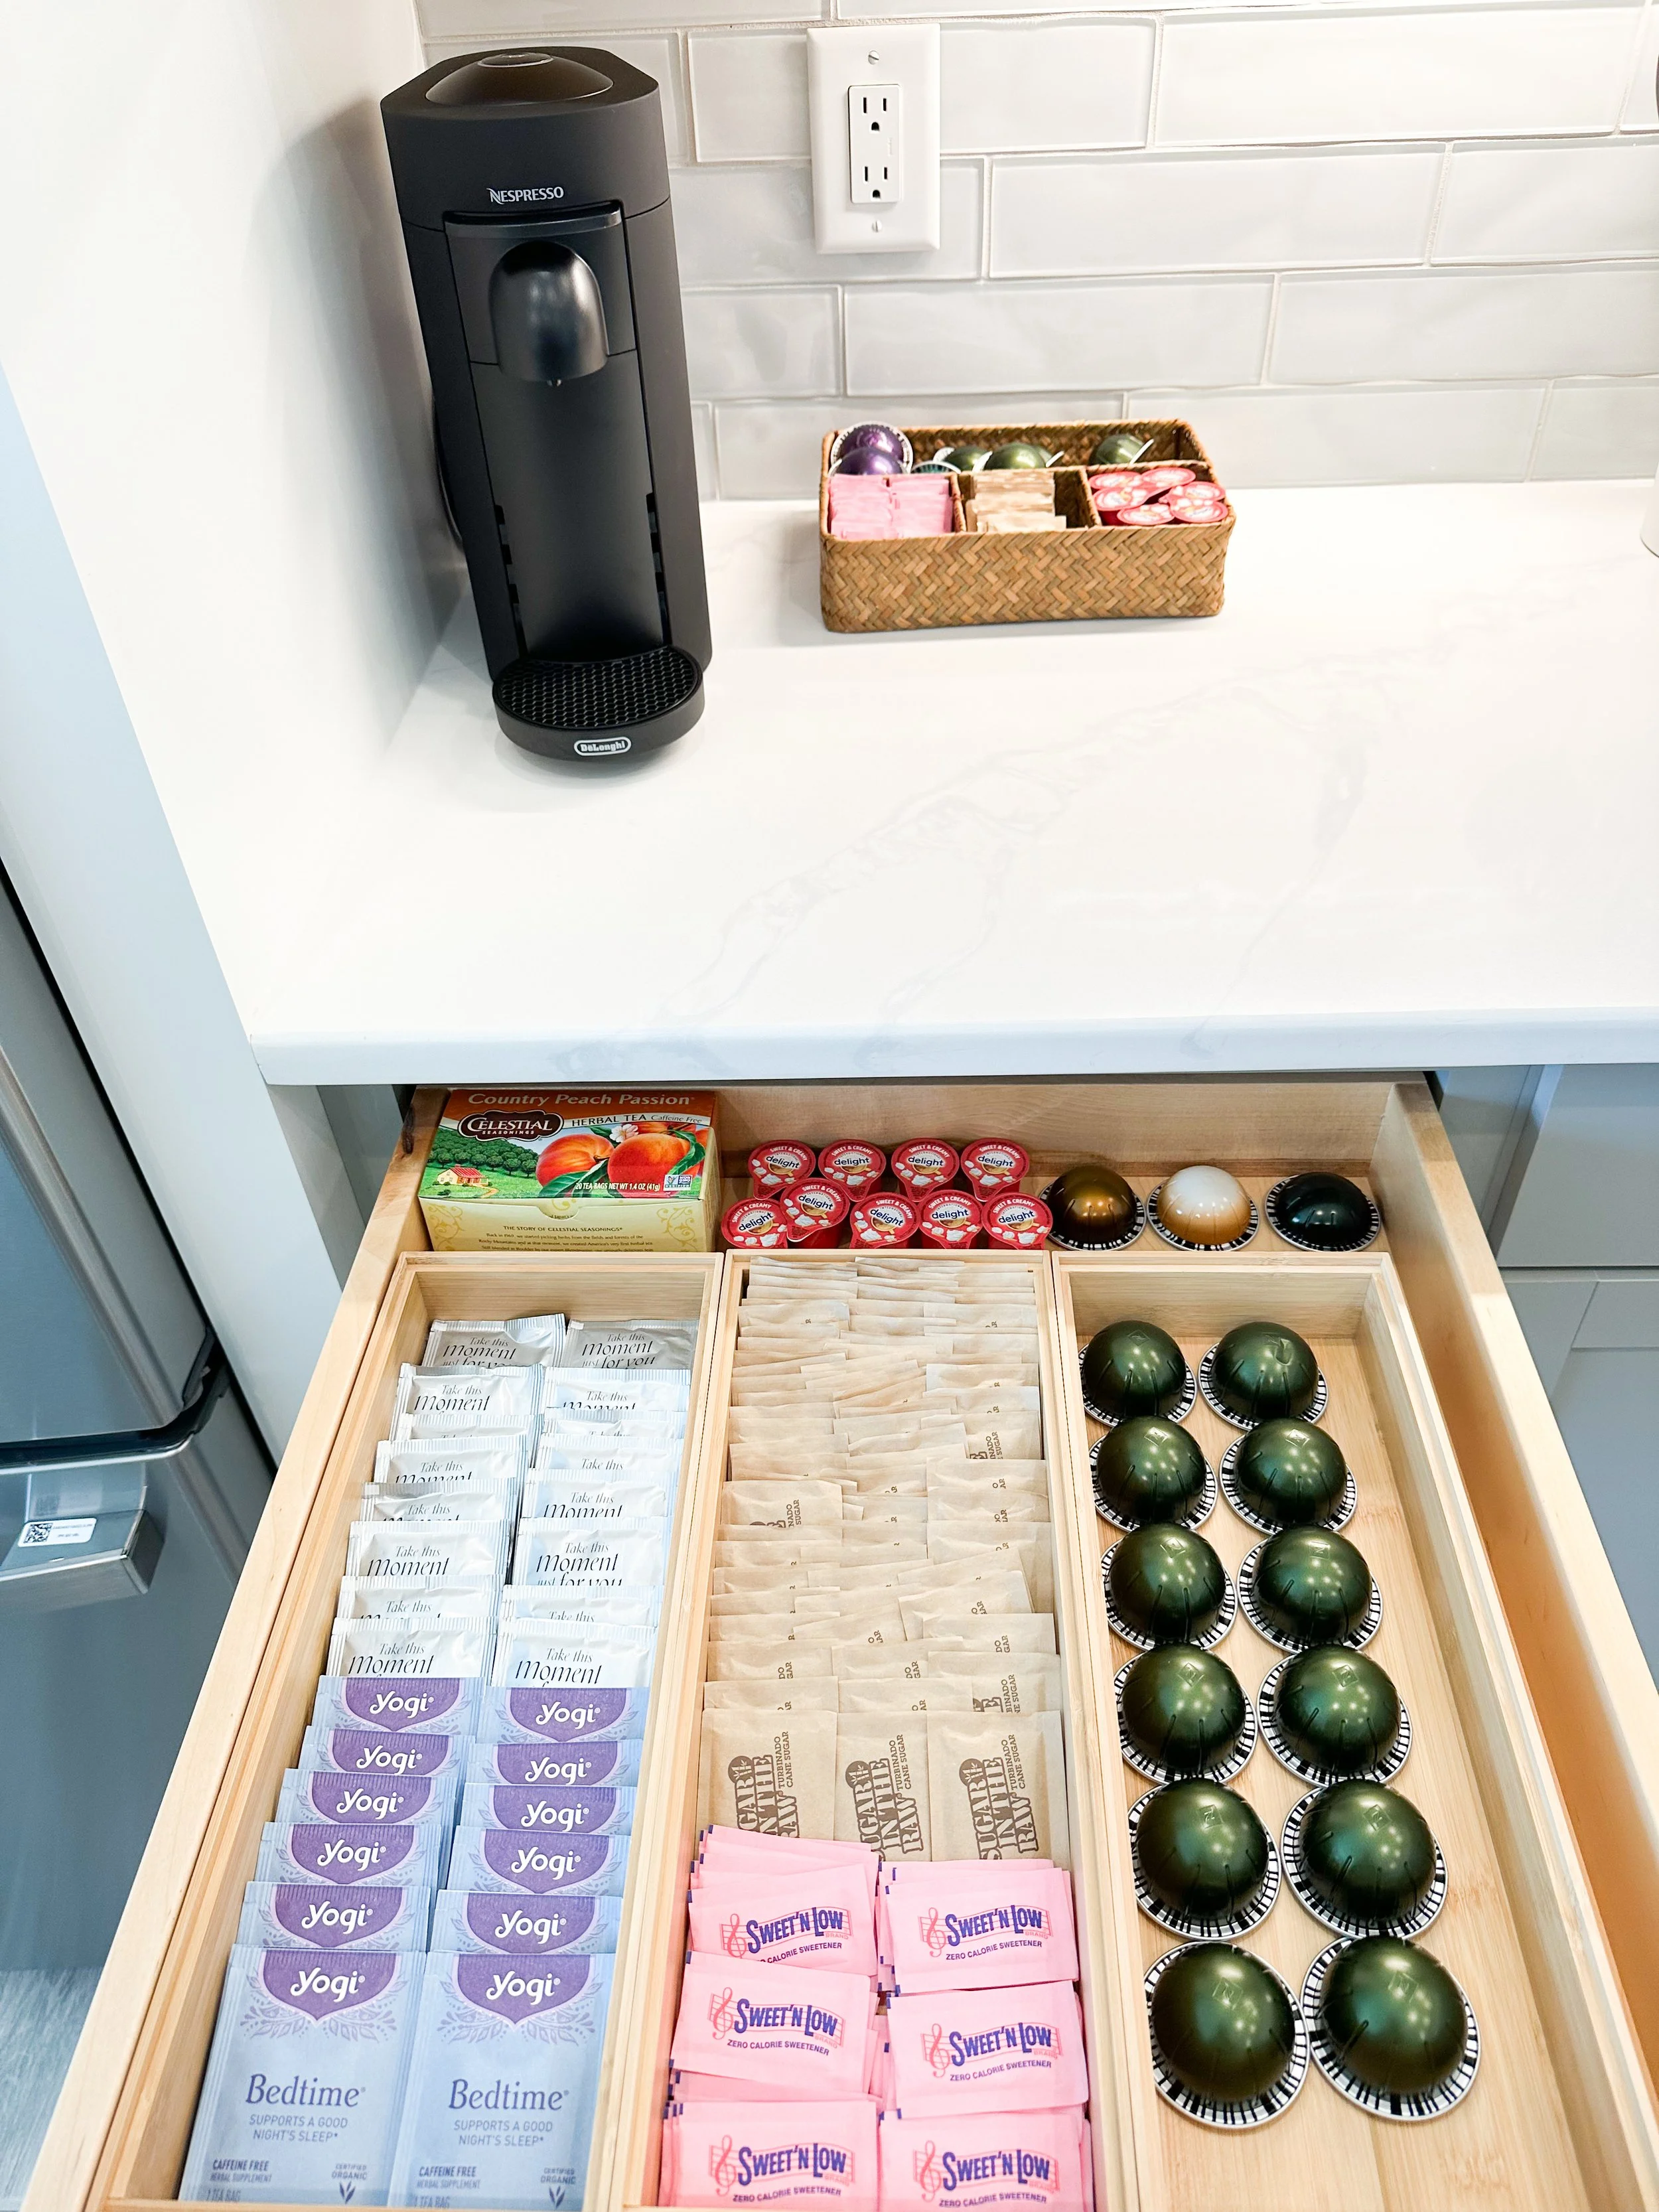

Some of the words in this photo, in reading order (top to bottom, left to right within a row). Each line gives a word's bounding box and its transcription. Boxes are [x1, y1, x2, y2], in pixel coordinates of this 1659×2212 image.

[486, 186, 564, 204] NESPRESSO
[469, 1094, 549, 1106] Country
[555, 1094, 612, 1104] Peach
[618, 1094, 690, 1105] Passion
[467, 1117, 553, 1131] CELESTIAL
[571, 1116, 618, 1126] HERBAL
[766, 1155, 800, 1169] delight
[834, 1156, 870, 1166] delight
[908, 1156, 944, 1167] delight
[977, 1155, 1015, 1167] delight
[798, 1195, 834, 1211] delight
[950, 1196, 972, 1206] CREAMY
[1012, 1198, 1035, 1207] CREAMY
[739, 1212, 774, 1232] delight
[870, 1208, 904, 1226] delight
[932, 1209, 970, 1220] delight
[998, 1210, 1035, 1224] delight
[470, 1337, 490, 1346] Take
[493, 1337, 510, 1347] this
[607, 1333, 626, 1342] Take
[443, 1345, 516, 1360] Moment
[581, 1341, 654, 1356] Moment
[442, 1384, 463, 1394] Take
[465, 1384, 482, 1394] this
[587, 1390, 608, 1401] Take
[610, 1391, 628, 1402] this
[413, 1395, 490, 1411] Moment
[421, 1461, 443, 1473] Take
[445, 1460, 464, 1471] this
[581, 1458, 604, 1470] Take
[605, 1459, 624, 1470] this
[571, 1491, 593, 1504] Take
[595, 1492, 615, 1504] this
[407, 1503, 429, 1515] Take
[432, 1503, 451, 1514] this
[543, 1504, 623, 1518] Moment
[396, 1546, 418, 1557] Take
[421, 1544, 441, 1557] this
[565, 1542, 588, 1554] Take
[591, 1541, 610, 1553] this
[367, 1557, 450, 1576] Moment
[536, 1553, 619, 1572] Moment
[386, 1600, 409, 1613] Take
[411, 1600, 432, 1612] this
[380, 1643, 403, 1655] Take
[405, 1642, 426, 1655] this
[547, 1648, 570, 1662] Take
[573, 1649, 593, 1662] this
[348, 1655, 435, 1674] Moment
[515, 1660, 603, 1684] Moment
[1001, 1679, 1012, 1712] BINADO
[1009, 1674, 1019, 1703] SUGAR
[782, 1731, 791, 1760] SUGAR
[897, 1734, 909, 1762] SUGAR
[1009, 1734, 1021, 1763] SUGAR
[774, 1736, 785, 1789] TURBINADO
[889, 1740, 902, 1791] TURBINADO
[1001, 1739, 1017, 1791] TURBINADO
[784, 1761, 794, 1788] CANE
[901, 1763, 911, 1790] CANE
[1015, 1764, 1026, 1790] CANE
[746, 1911, 811, 1954] SWEET'N
[812, 1907, 843, 1937] LOW
[945, 1908, 1010, 1947] SWEET'N
[1011, 1905, 1042, 1934] LOW
[767, 1949, 798, 1963] CALORIE
[799, 1942, 842, 1953] SWEETENER
[968, 1944, 998, 1958] CALORIE
[999, 1940, 1043, 1949] SWEETENER
[734, 1998, 804, 2033] SWEET'N
[804, 2005, 838, 2037] LOW
[727, 2039, 748, 2049] ZERO
[750, 2041, 782, 2049] CALORIE
[784, 2041, 830, 2056] SWEETENER
[949, 2026, 1017, 2067] SWEET'N
[1018, 2022, 1051, 2053] LOW
[972, 2065, 1005, 2079] CALORIE
[1006, 2060, 1052, 2070] SWEETENER
[245, 2073, 359, 2107] Bedtime
[448, 2079, 563, 2110] Bedtime
[250, 2114, 305, 2127] SUPPORTS
[307, 2116, 315, 2127] A
[318, 2116, 348, 2129] GOOD
[454, 2120, 510, 2132] SUPPORTS
[512, 2121, 520, 2132] A
[523, 2120, 553, 2132] GOOD
[253, 2129, 295, 2142] NIGHT'S
[459, 2134, 501, 2146] NIGHT'S
[212, 2159, 247, 2171] CAFFEINE
[248, 2160, 269, 2172] FREE
[419, 2166, 456, 2177] CAFFEINE
[457, 2166, 476, 2177] FREE
[737, 2145, 809, 2186] SWEET'N
[813, 2143, 847, 2177] LOW
[942, 2150, 1013, 2191] SWEET'N
[1017, 2149, 1050, 2184] LOW
[331, 2171, 368, 2180] ORGANIC
[540, 2175, 576, 2185] ORGANIC
[733, 2193, 755, 2202] ZERO
[757, 2188, 792, 2201] CALORIE
[794, 2186, 841, 2195] SWEETENER
[939, 2198, 961, 2208] ZERO
[963, 2193, 997, 2207] CALORIE
[999, 2191, 1047, 2203] SWEETENER
